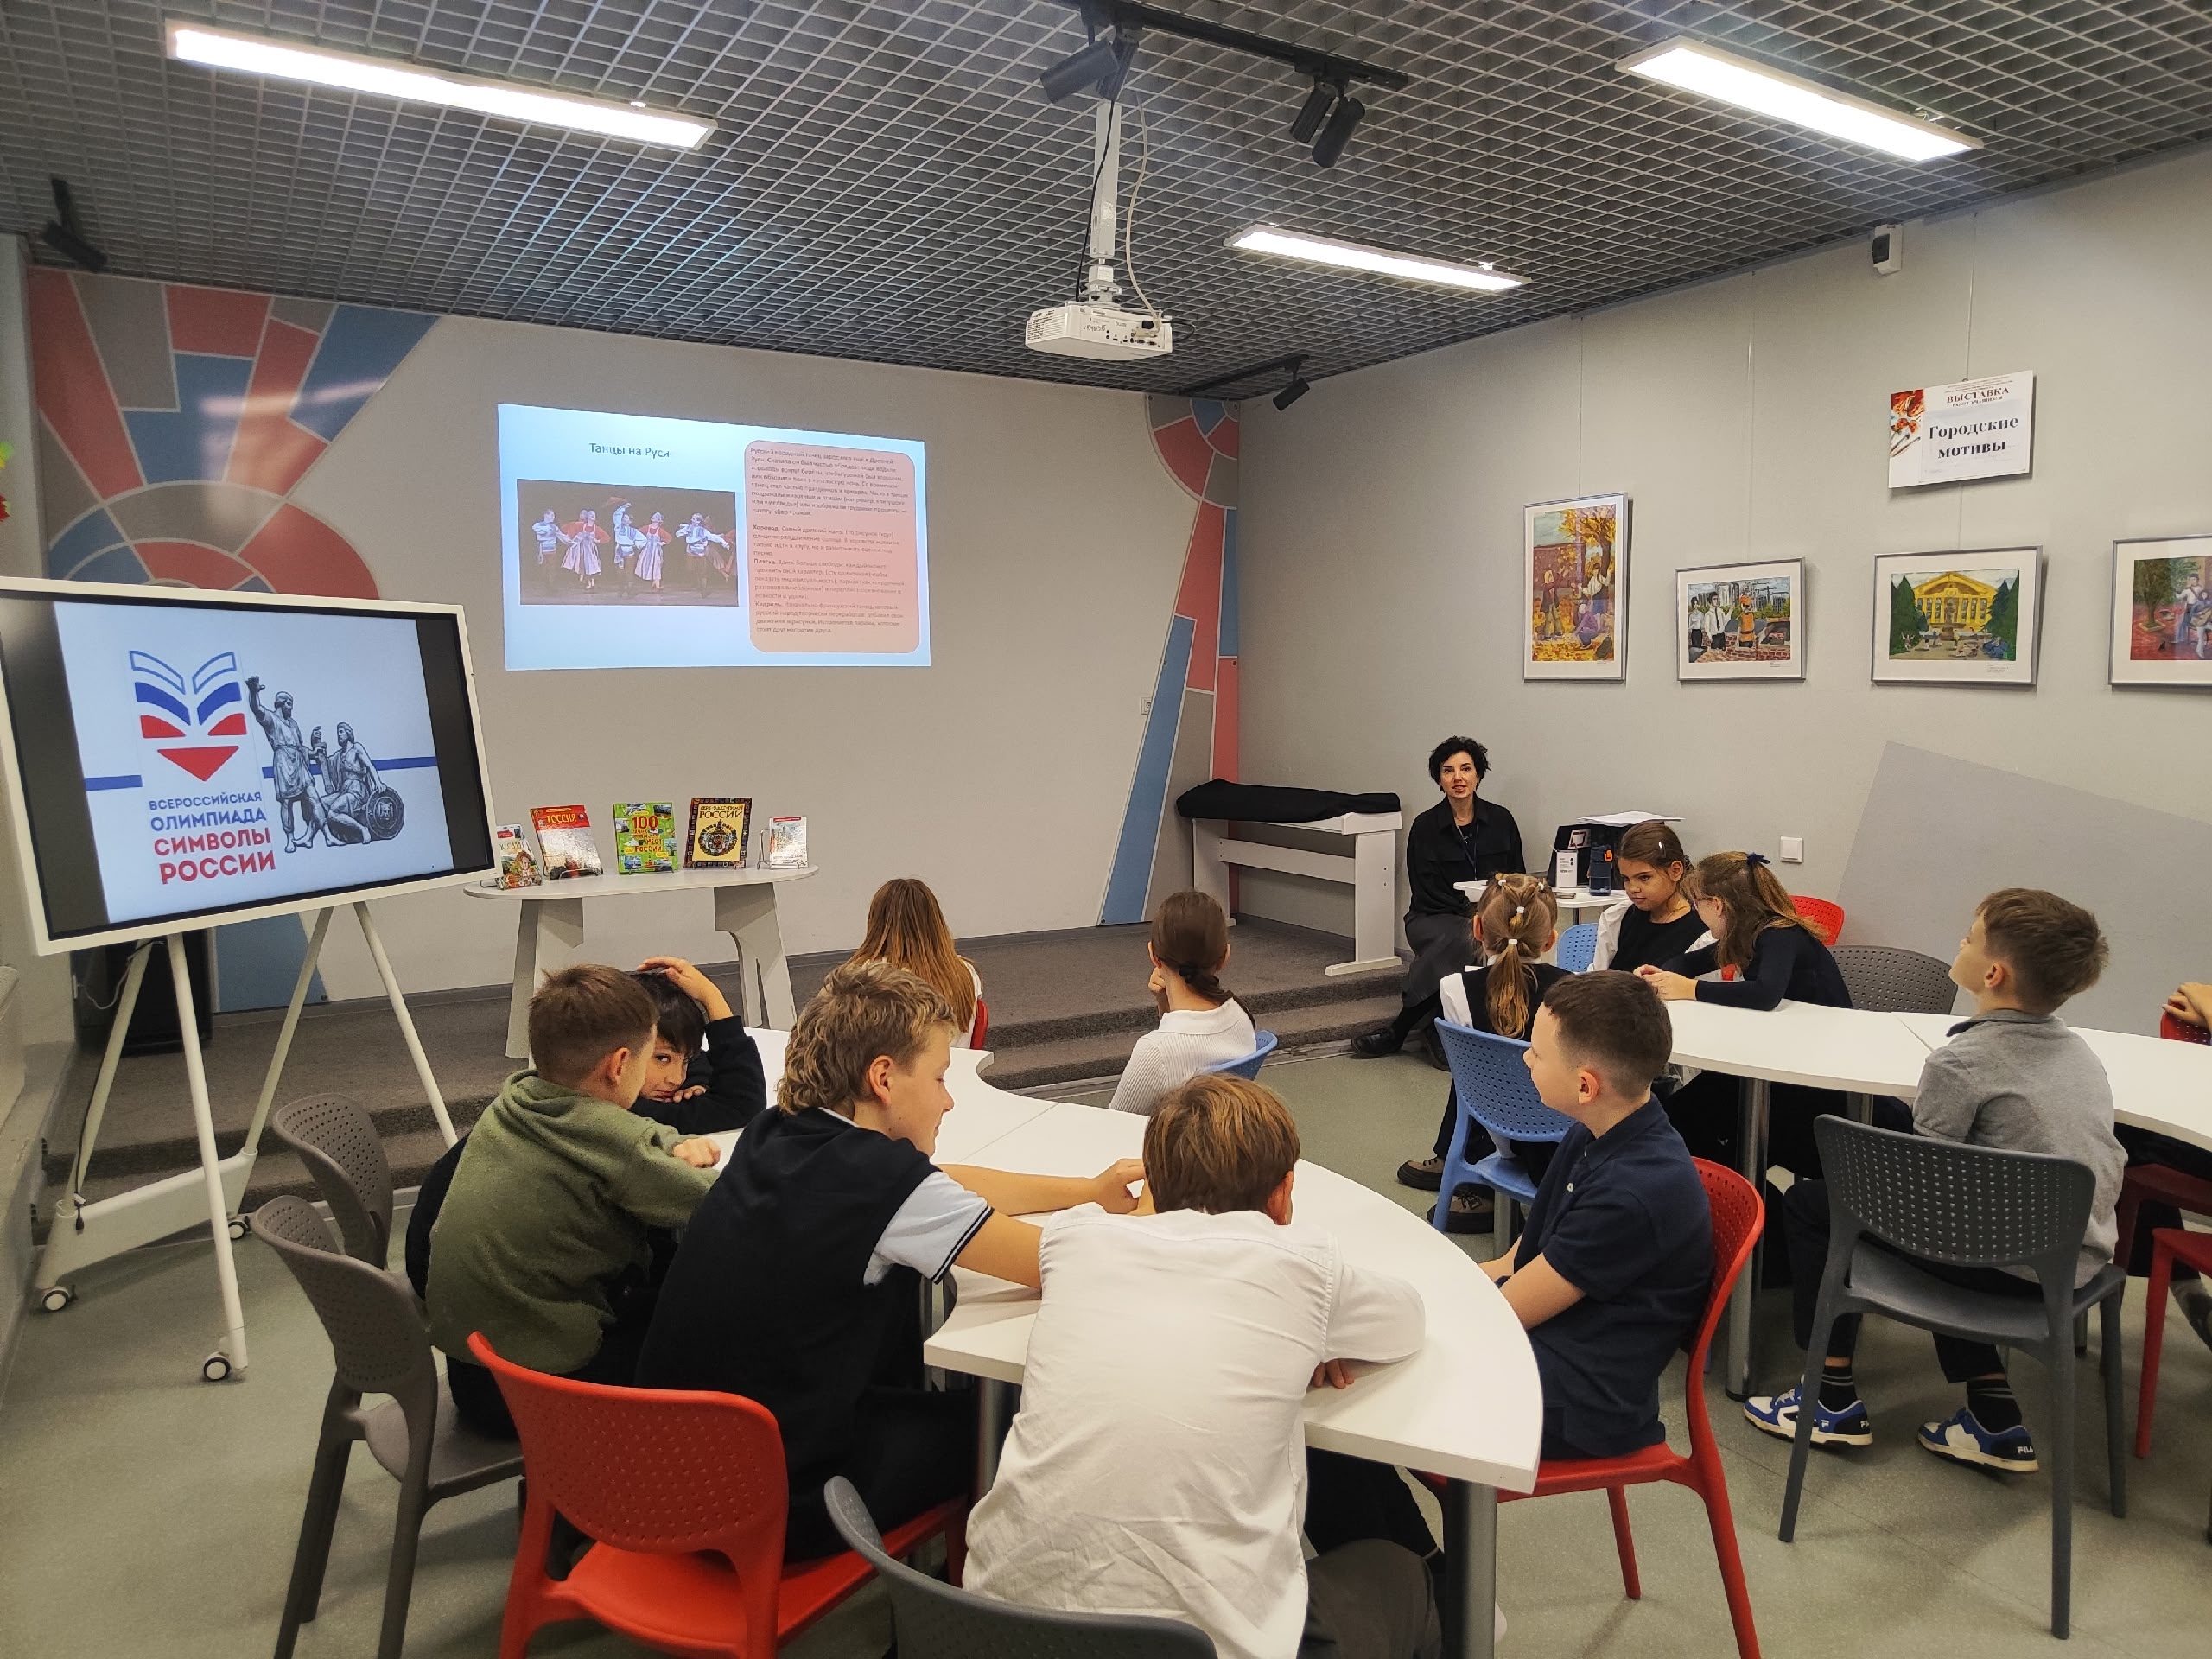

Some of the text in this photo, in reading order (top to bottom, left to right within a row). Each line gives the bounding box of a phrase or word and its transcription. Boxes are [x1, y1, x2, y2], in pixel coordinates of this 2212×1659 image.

[1947, 387, 2009, 404] ВЫСТАВКА
[1929, 417, 2018, 439] Городские
[589, 442, 670, 459] Танцы на Руси
[1938, 441, 2006, 459] мотивы
[149, 791, 262, 810] ВСЕРОССИЙСКАЯ
[150, 807, 267, 831] ОЛИМПИАДА
[547, 813, 577, 823] РОССИЯ
[632, 815, 658, 829] 100
[154, 827, 271, 856] СИМВОЛЫ
[159, 849, 276, 885] РОССИИ
